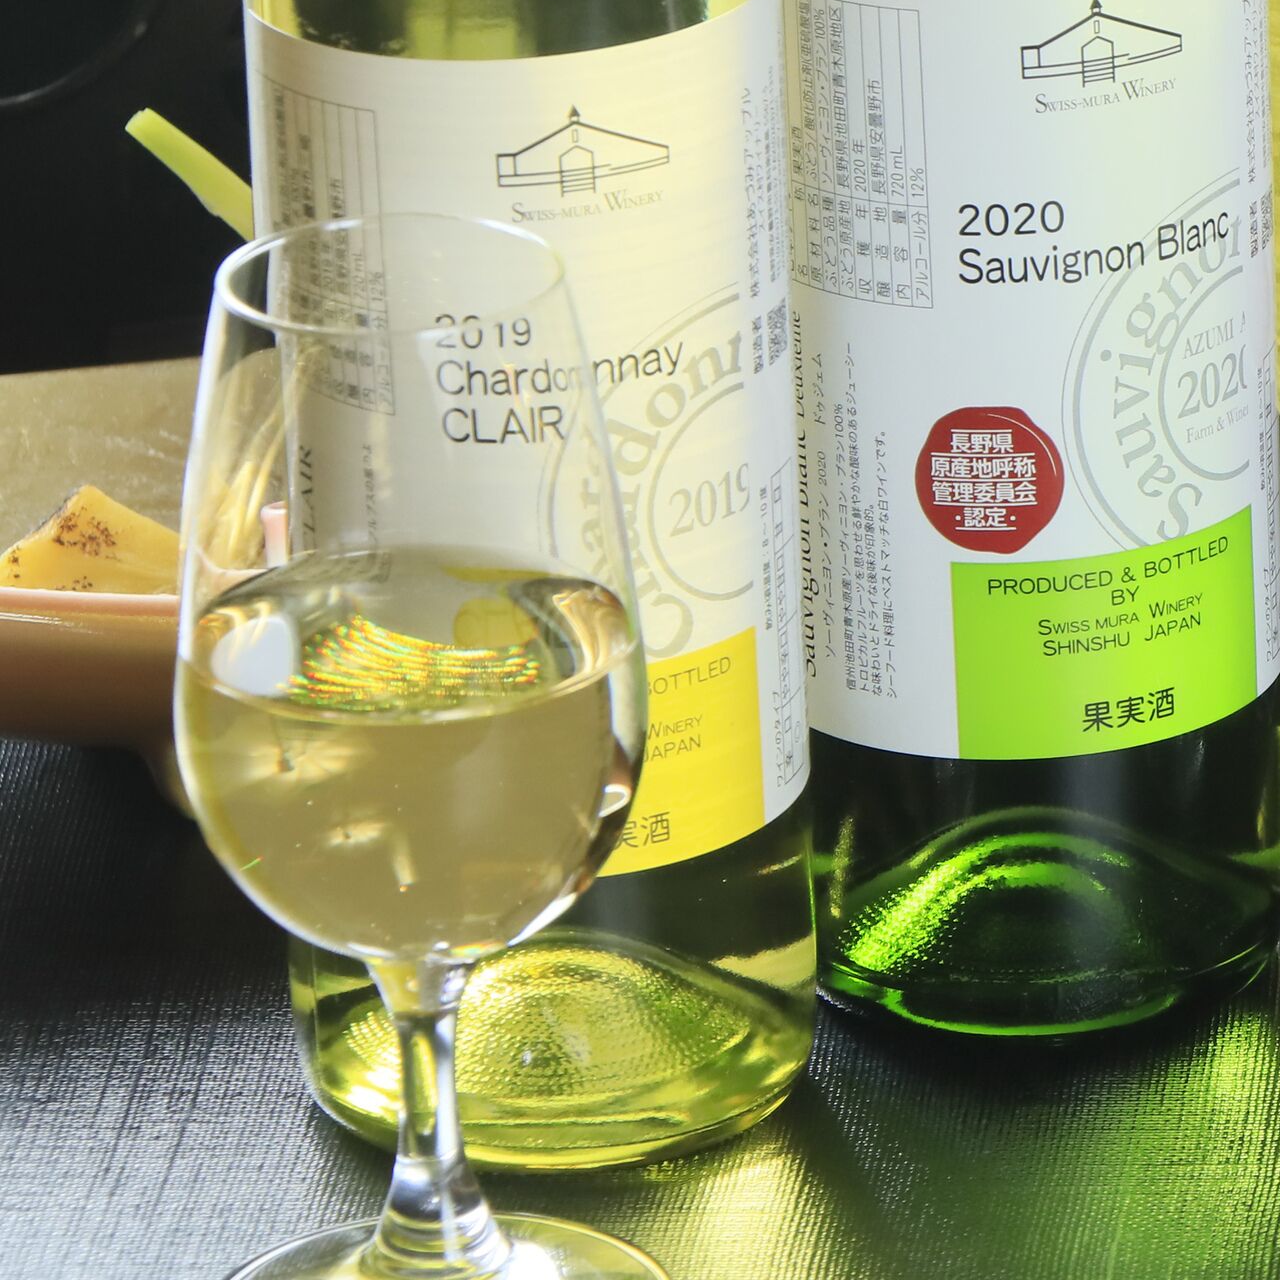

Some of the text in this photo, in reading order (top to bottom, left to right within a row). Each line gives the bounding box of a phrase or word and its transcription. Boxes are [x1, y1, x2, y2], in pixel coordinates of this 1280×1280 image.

[910, 167, 930, 302] アルコール分 12%
[958, 200, 1065, 236] 2020
[958, 211, 1230, 285] Sauvignon Blanc
[1183, 319, 1234, 359] AZUMI
[442, 407, 567, 445] CLAIR
[949, 433, 1014, 452] 長野県
[1185, 421, 1214, 443] Farm
[1216, 416, 1225, 432] &
[930, 457, 1036, 477] 原産地呼称
[933, 482, 1037, 502] 管理委員会
[987, 535, 1229, 595] PRODUCED & BOTTLED
[1111, 586, 1138, 606] BY
[1042, 612, 1202, 657] SHINSHU JAPAN
[1082, 687, 1176, 733] 果実酒
